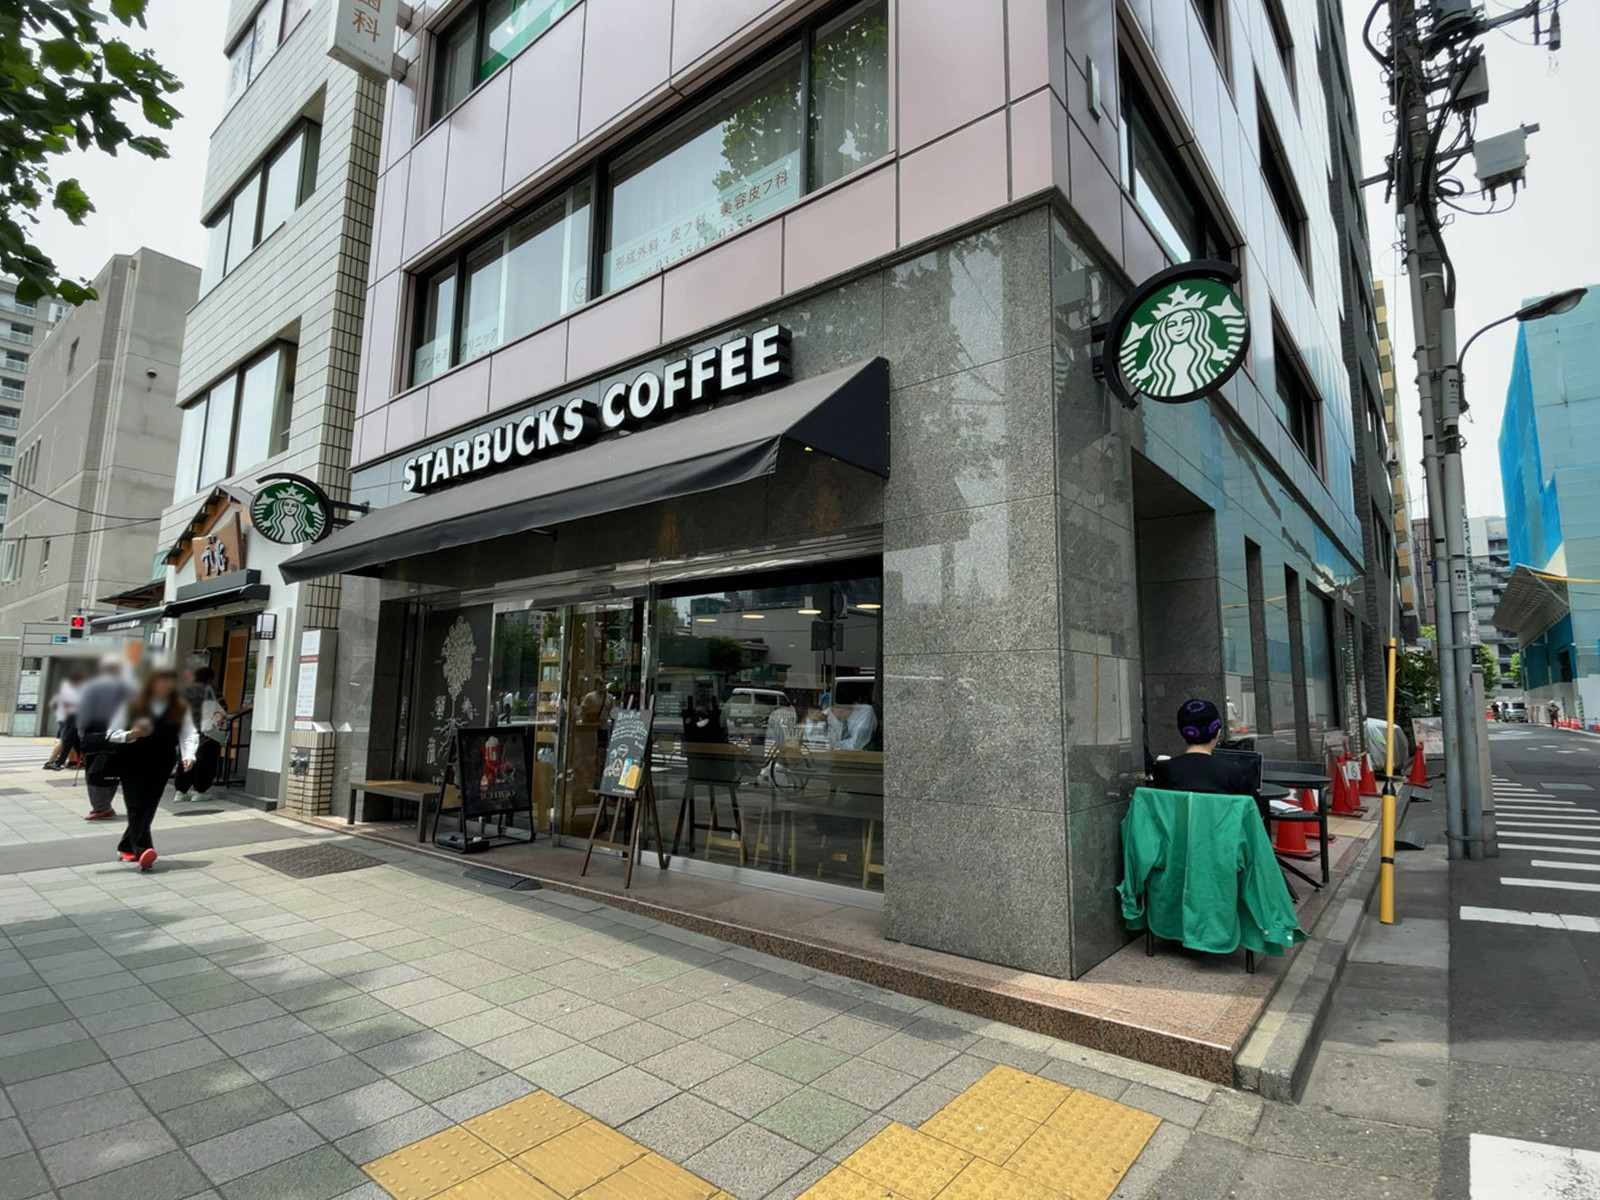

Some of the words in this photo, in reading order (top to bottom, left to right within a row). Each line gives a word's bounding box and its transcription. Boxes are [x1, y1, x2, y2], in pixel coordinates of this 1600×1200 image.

[352, 0, 380, 43] 科
[402, 397, 585, 492] STARBUCKS
[601, 323, 782, 429] COFFEE
